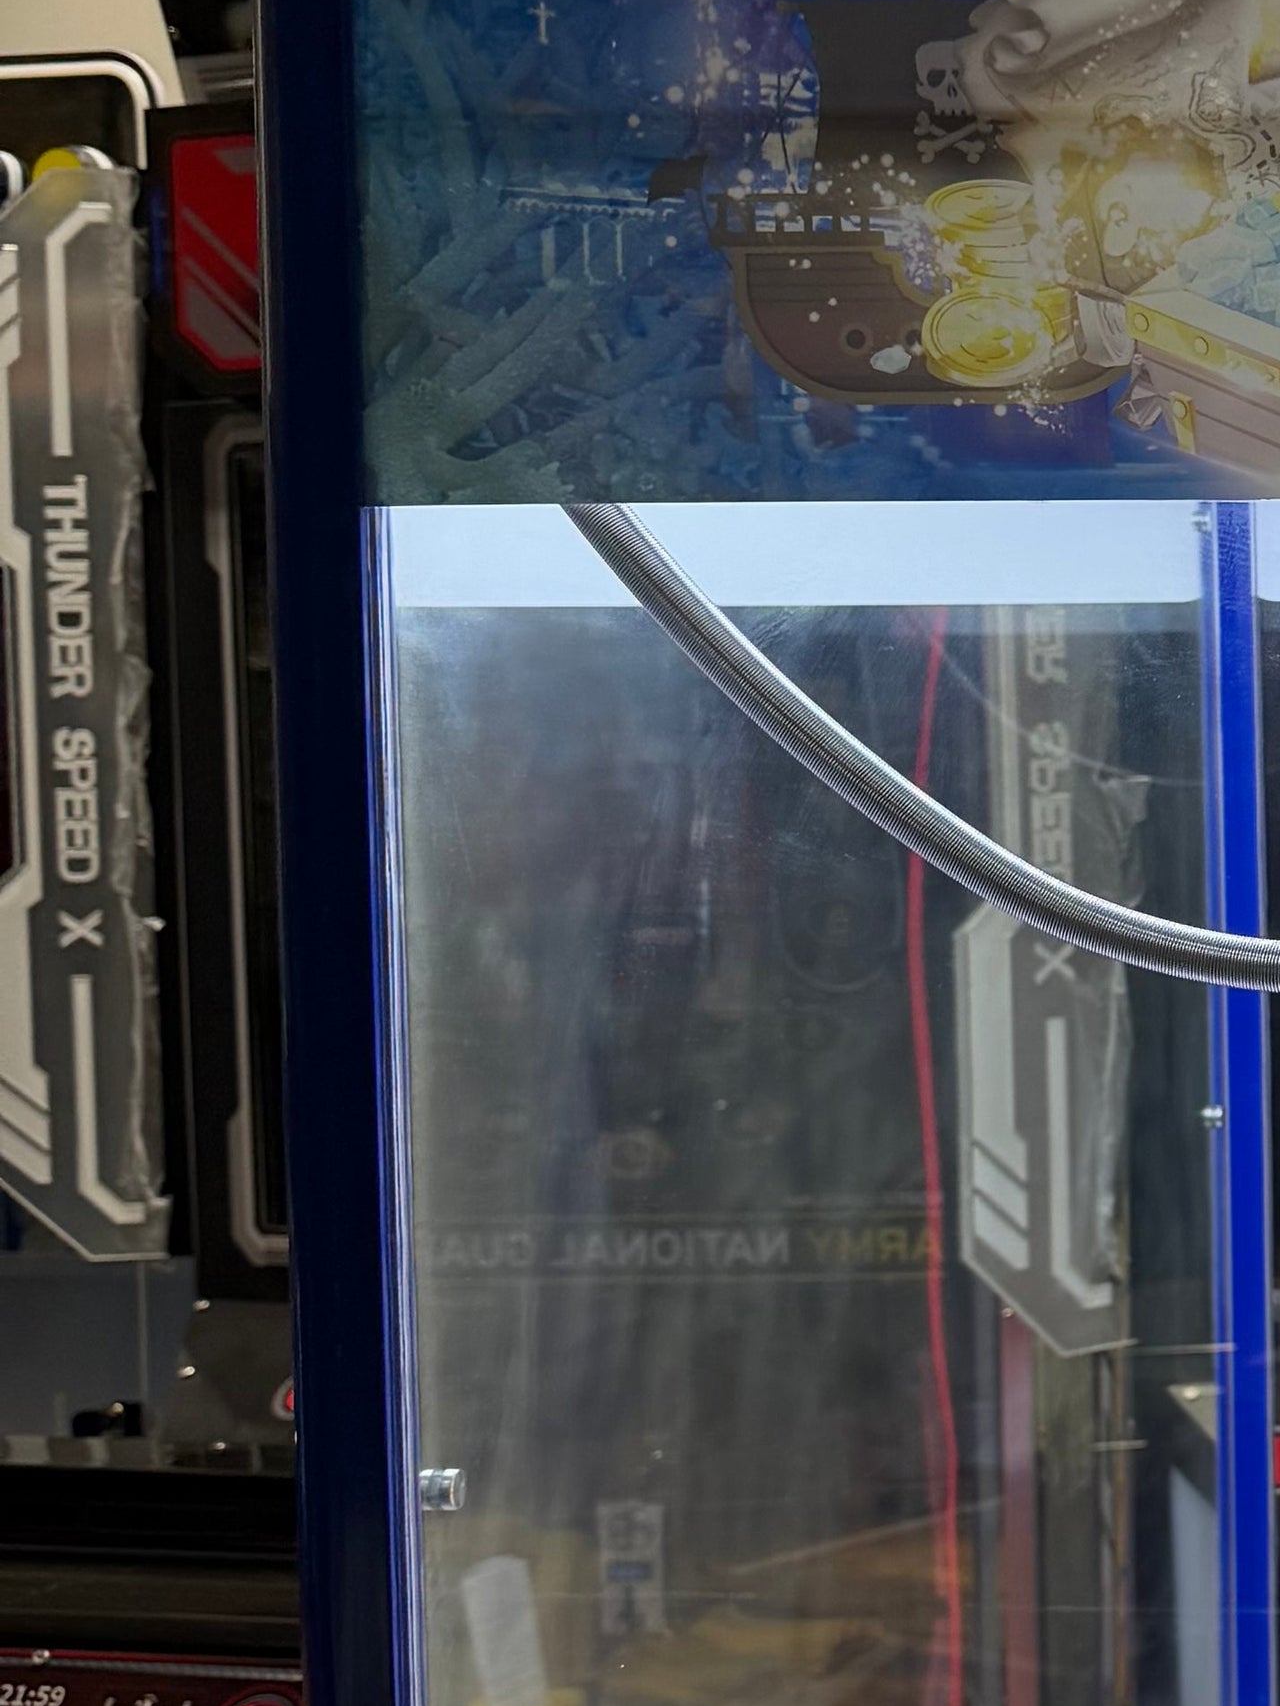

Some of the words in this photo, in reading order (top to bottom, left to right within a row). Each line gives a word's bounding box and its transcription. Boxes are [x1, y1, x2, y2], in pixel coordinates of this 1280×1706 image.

[42, 475, 93, 699] THUNDER
[50, 727, 100, 883] SPEED
[56, 910, 103, 949] X
